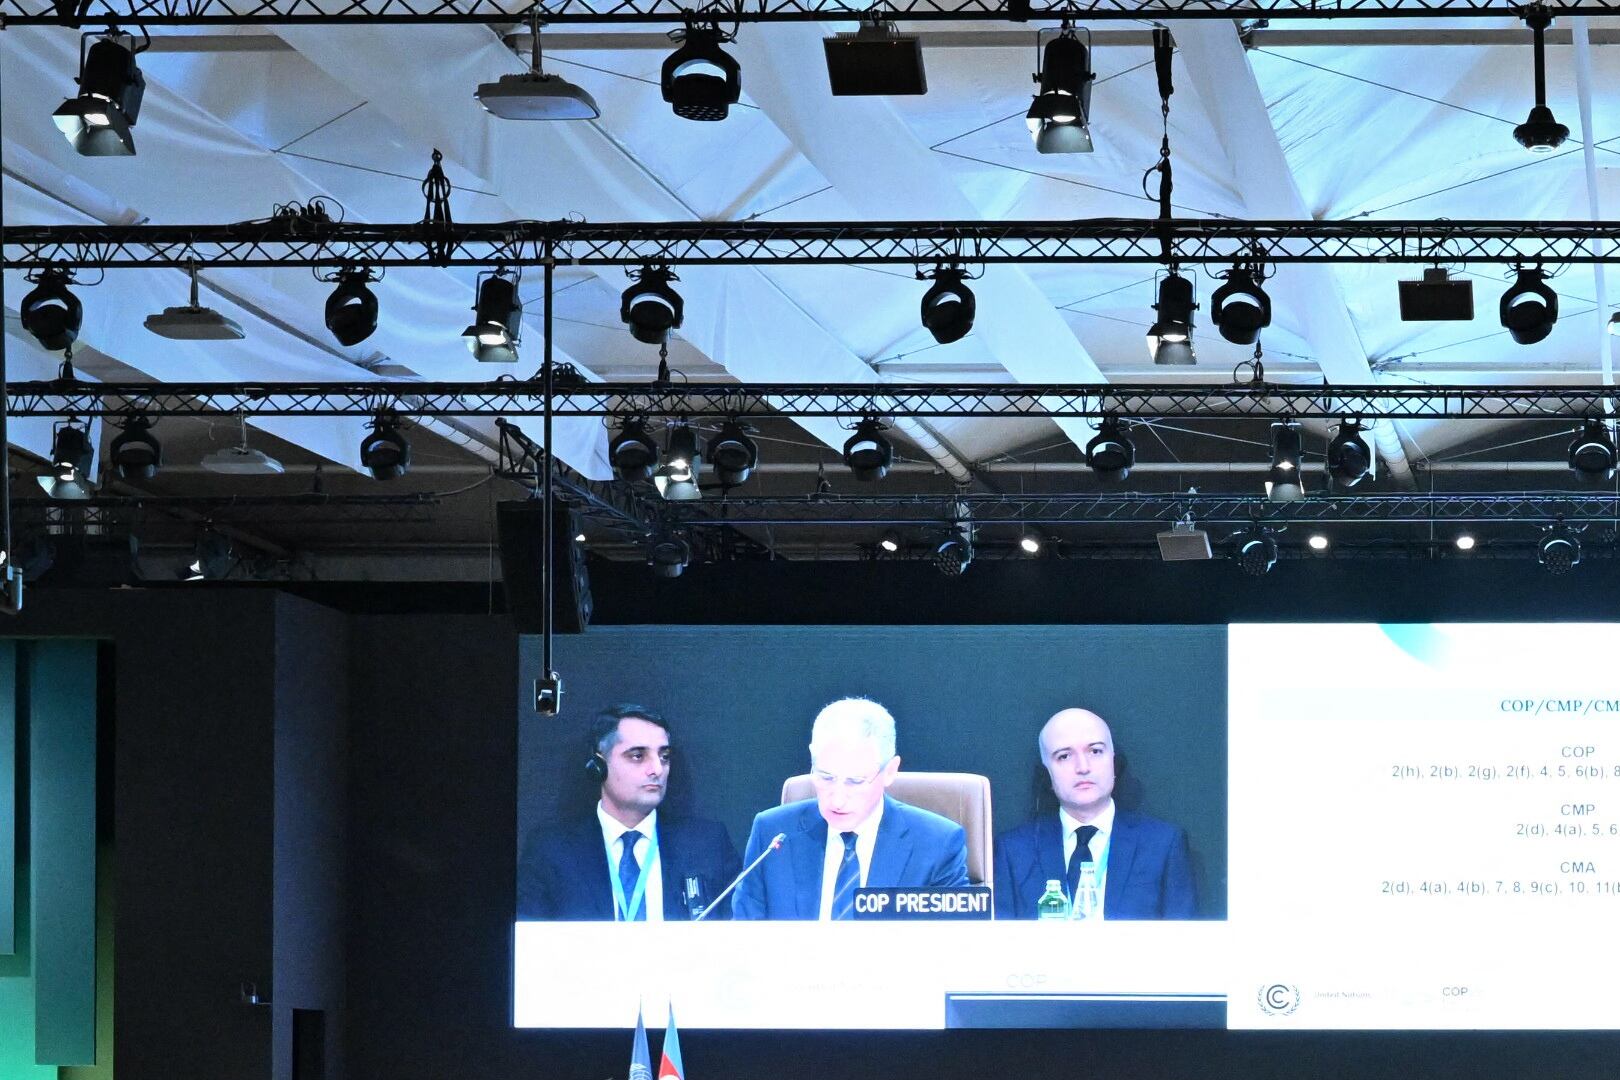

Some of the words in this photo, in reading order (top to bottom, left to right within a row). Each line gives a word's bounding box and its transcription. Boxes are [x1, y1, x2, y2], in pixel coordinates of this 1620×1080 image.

[1561, 746, 1596, 758] COP
[1560, 803, 1596, 817] CMP
[1560, 861, 1596, 874] CMA
[855, 892, 889, 913] COP
[896, 892, 989, 912] PRESIDENT
[1442, 986, 1469, 997] COP
